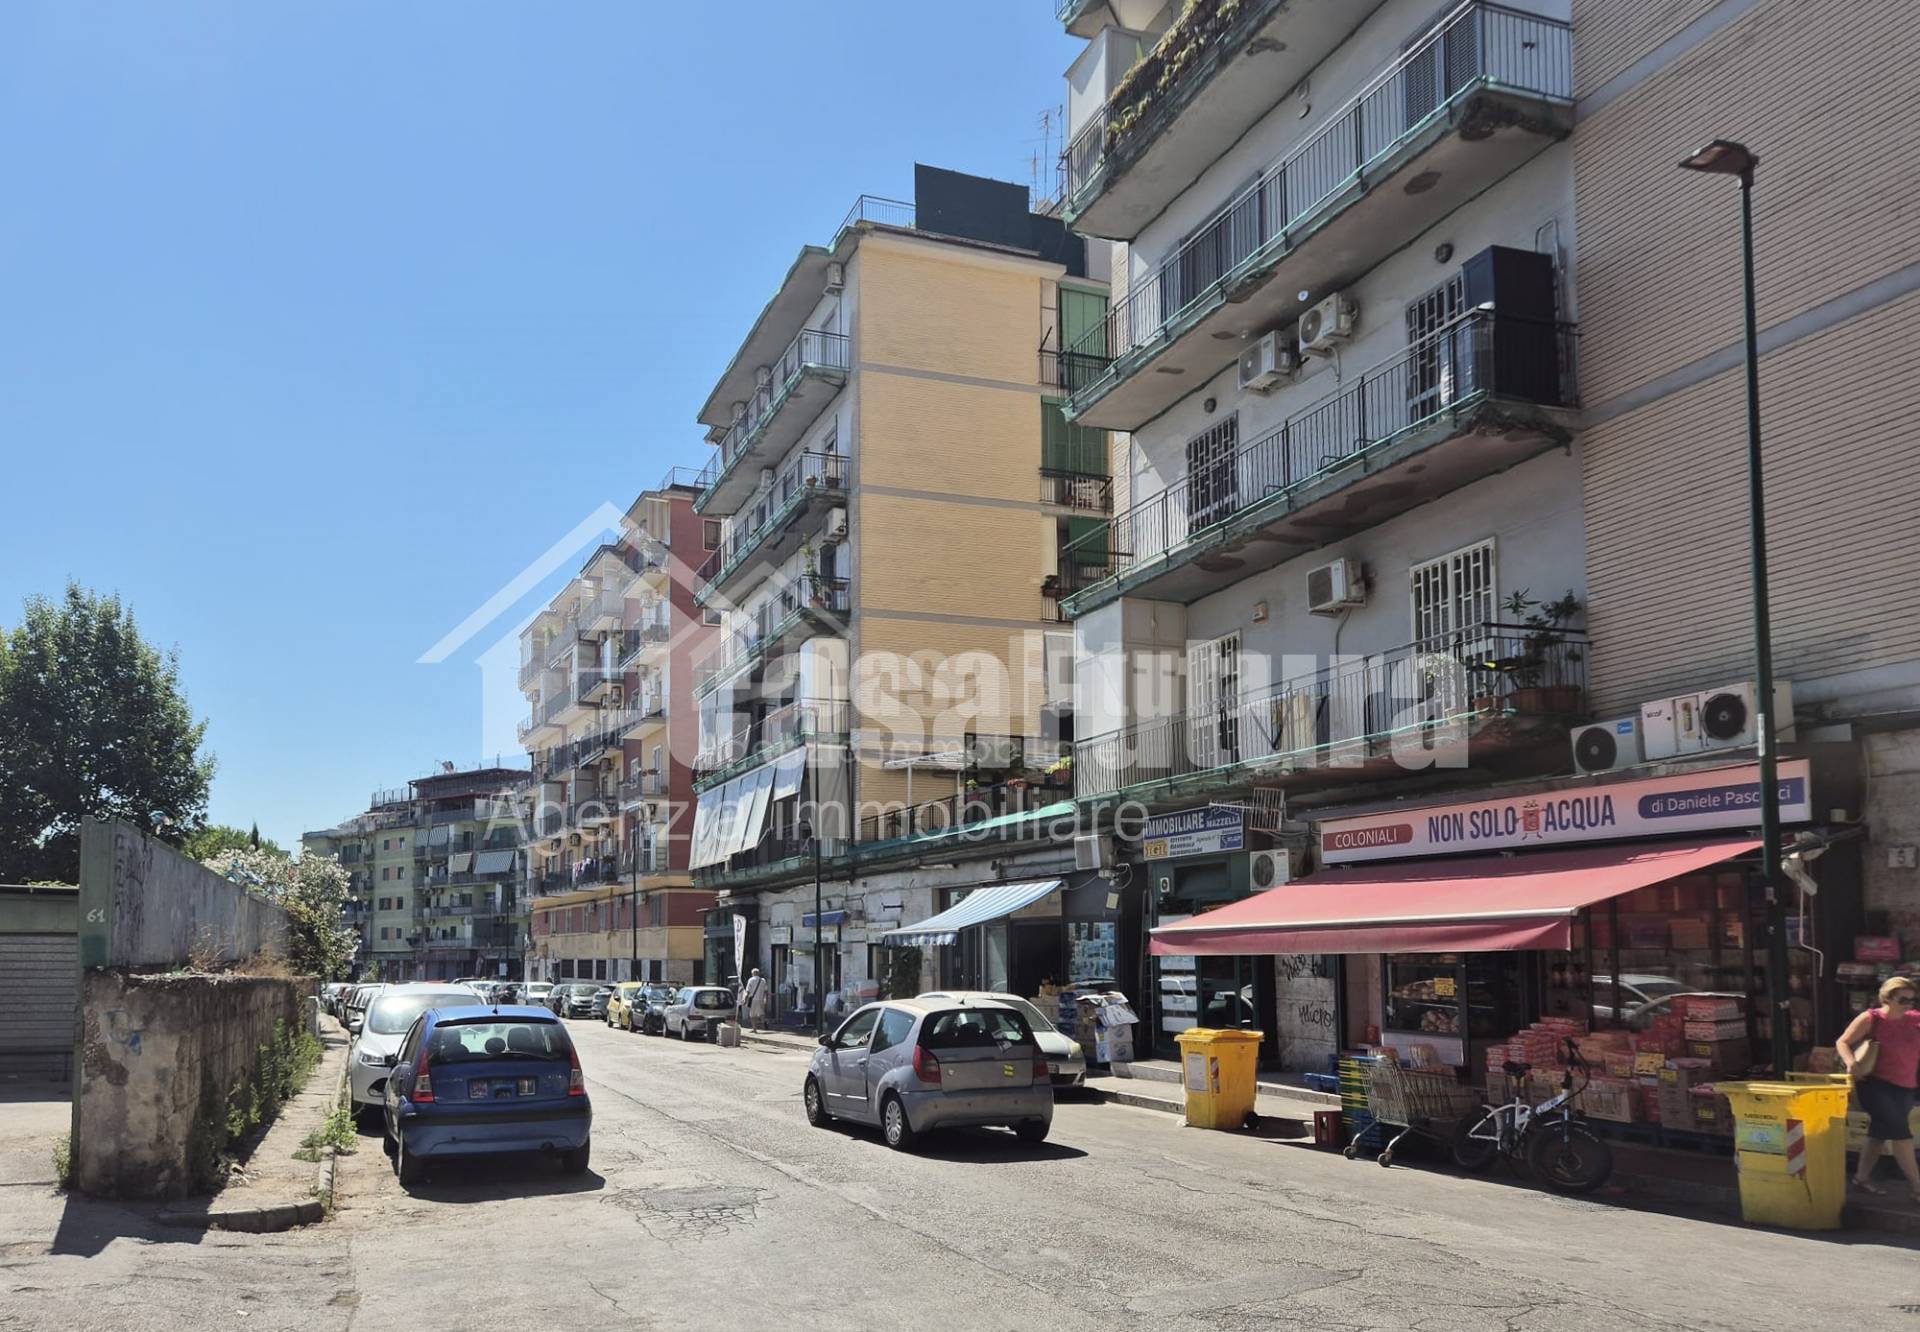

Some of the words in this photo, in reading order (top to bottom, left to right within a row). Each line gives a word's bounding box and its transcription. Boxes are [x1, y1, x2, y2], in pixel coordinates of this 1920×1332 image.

[1651, 801, 1664, 814] di
[1668, 796, 1721, 812] Daniele
[1725, 785, 1791, 805] Pascci
[1145, 812, 1204, 837] IMMOBILIARE
[1428, 814, 1464, 844] NON
[1470, 806, 1516, 840] SOLO
[1544, 795, 1616, 832] ACQUA
[1335, 828, 1397, 849] COLONIALI
[86, 908, 105, 922] 61
